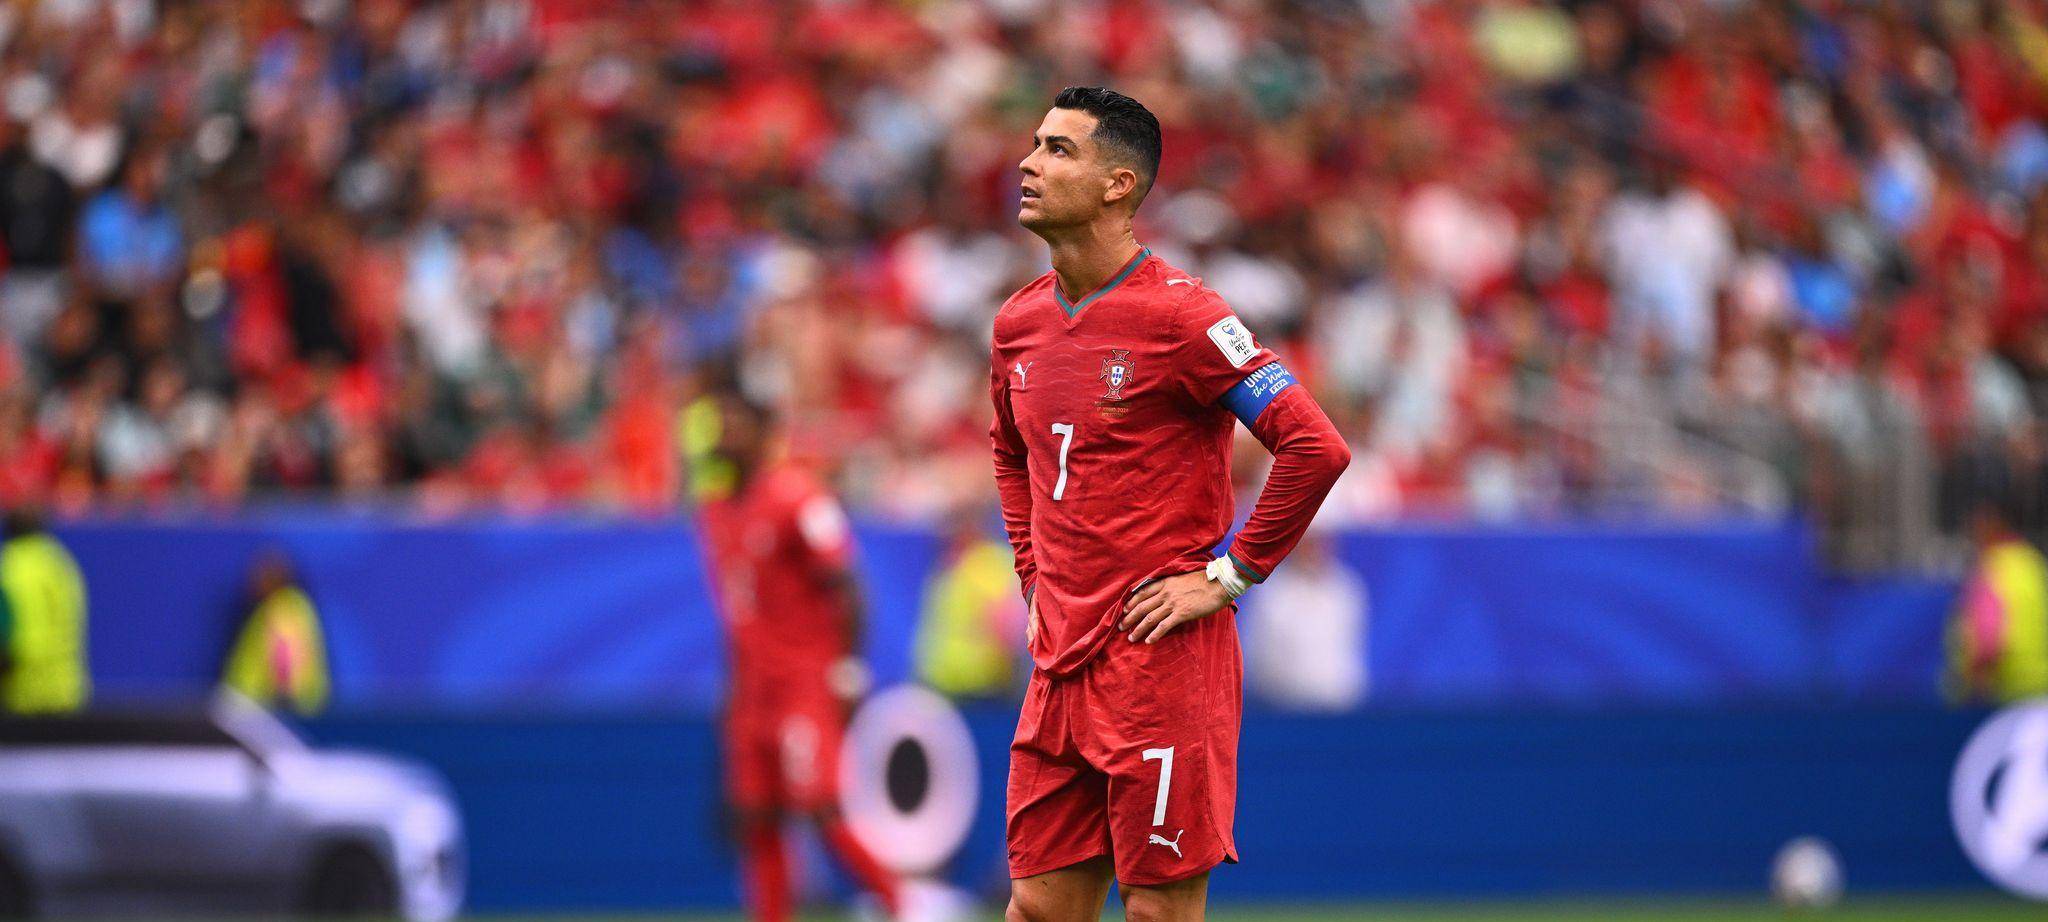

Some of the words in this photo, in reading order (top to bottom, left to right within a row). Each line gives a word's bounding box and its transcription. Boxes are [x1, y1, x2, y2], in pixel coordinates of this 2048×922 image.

[1252, 383, 1268, 398] the
[1052, 423, 1074, 501] 7
[1142, 746, 1175, 827] 7
